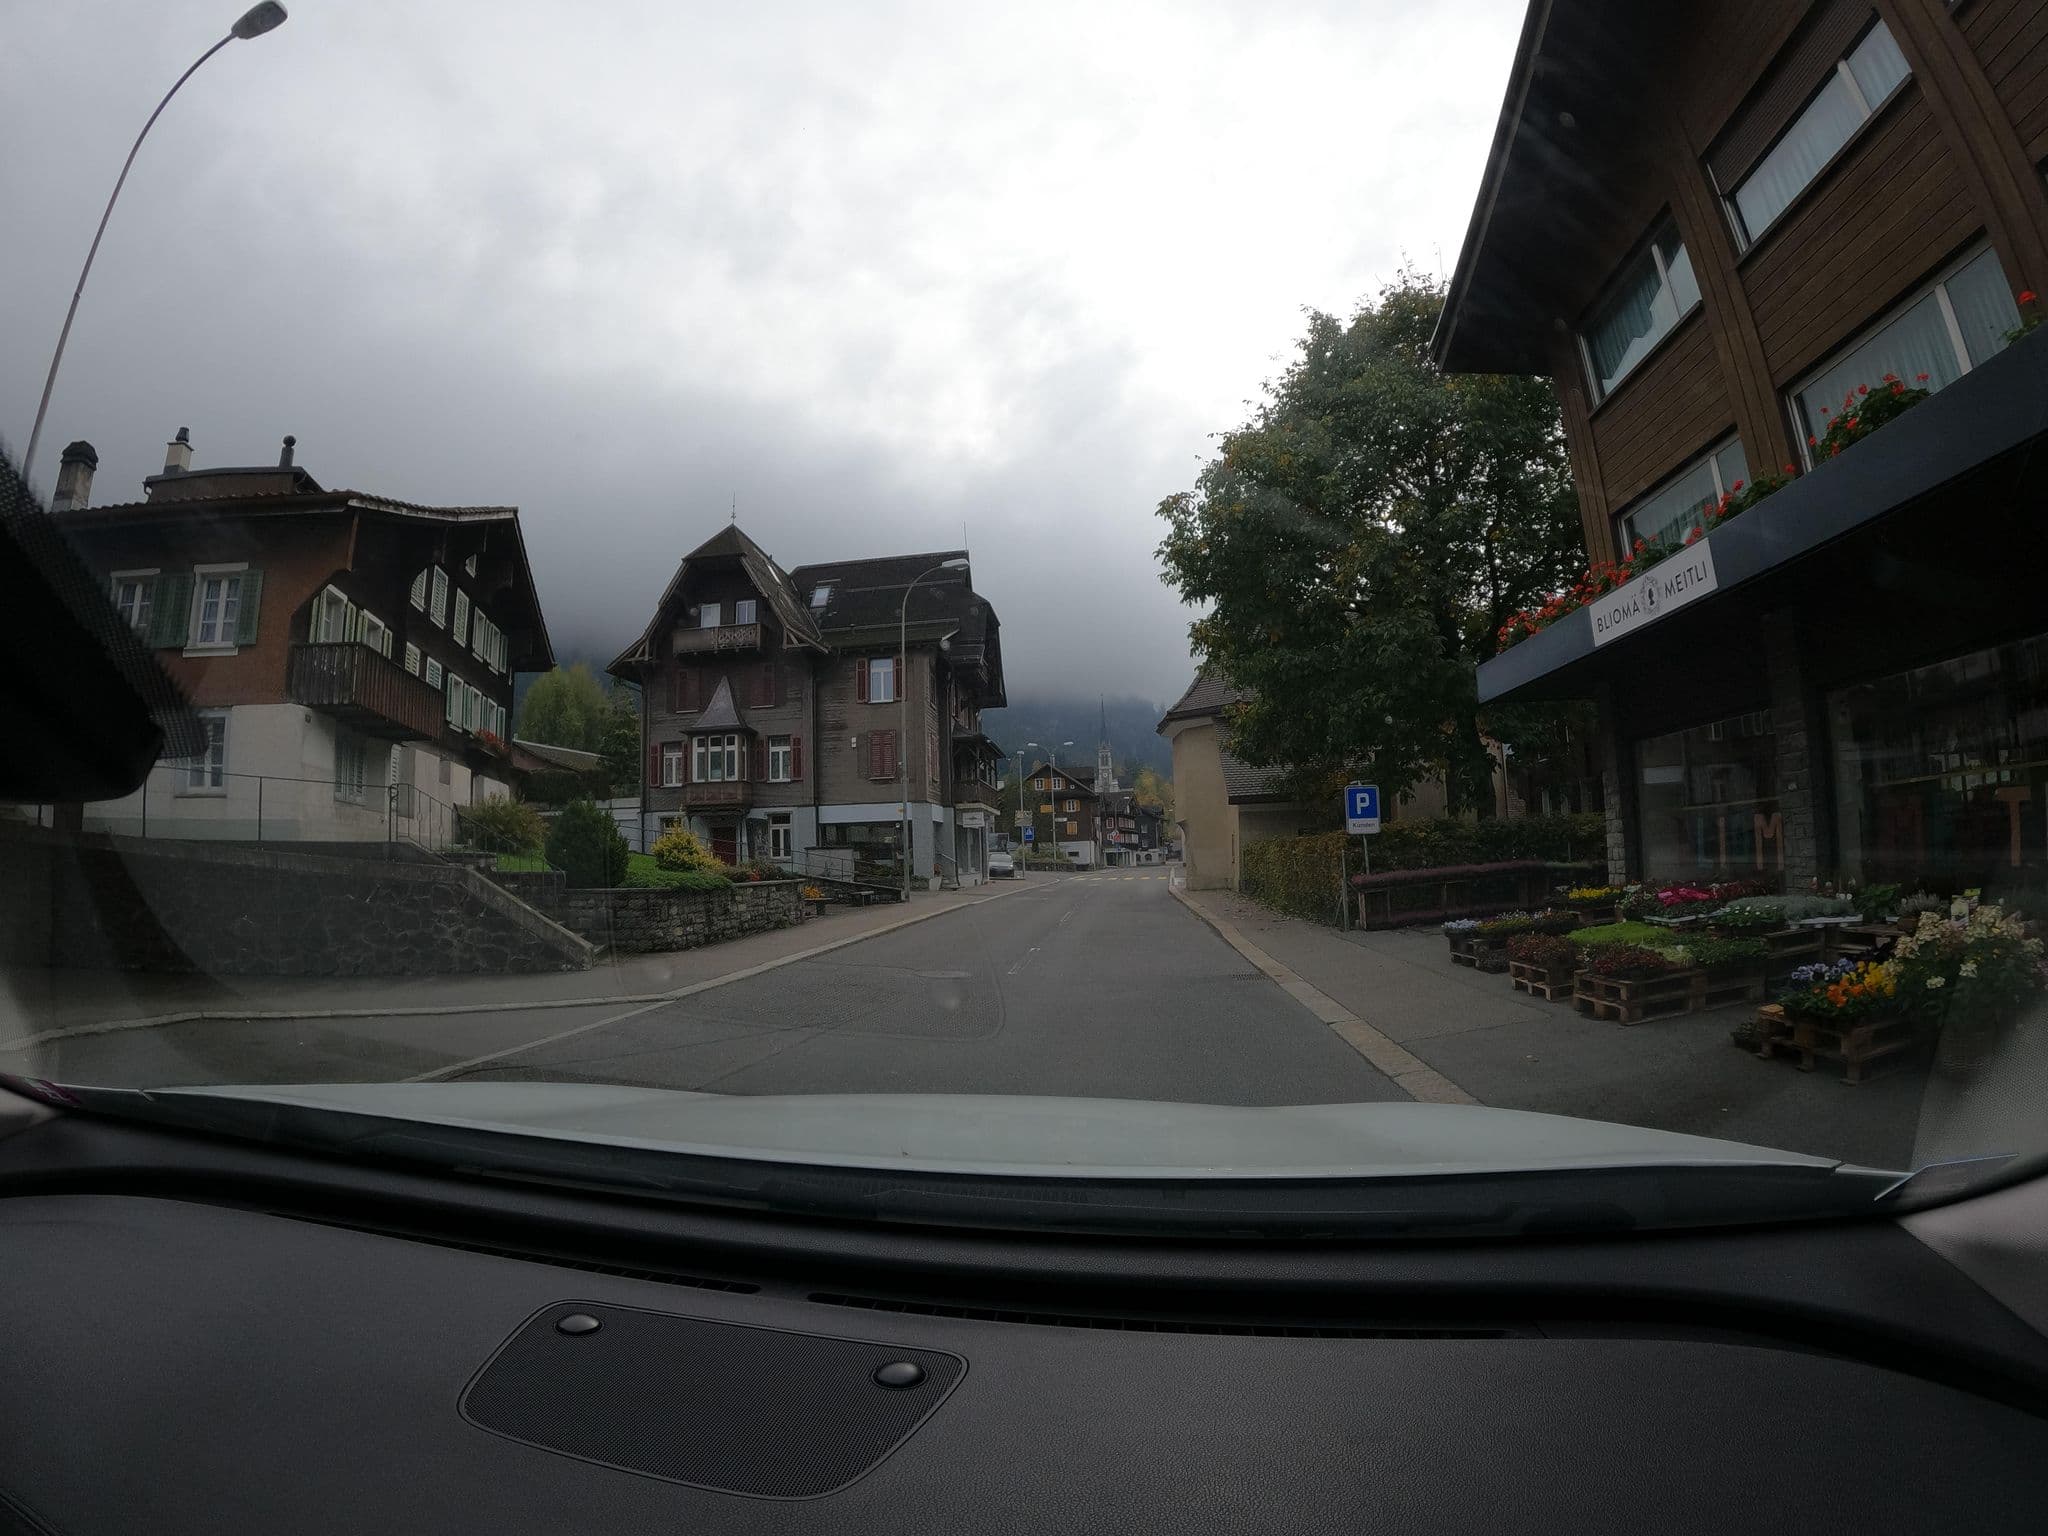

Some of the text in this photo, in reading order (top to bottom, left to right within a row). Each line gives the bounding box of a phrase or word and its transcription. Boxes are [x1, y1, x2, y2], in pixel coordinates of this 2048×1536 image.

[1597, 561, 1708, 633] BLIOMÄ MEITLI
[1356, 793, 1370, 815] P
